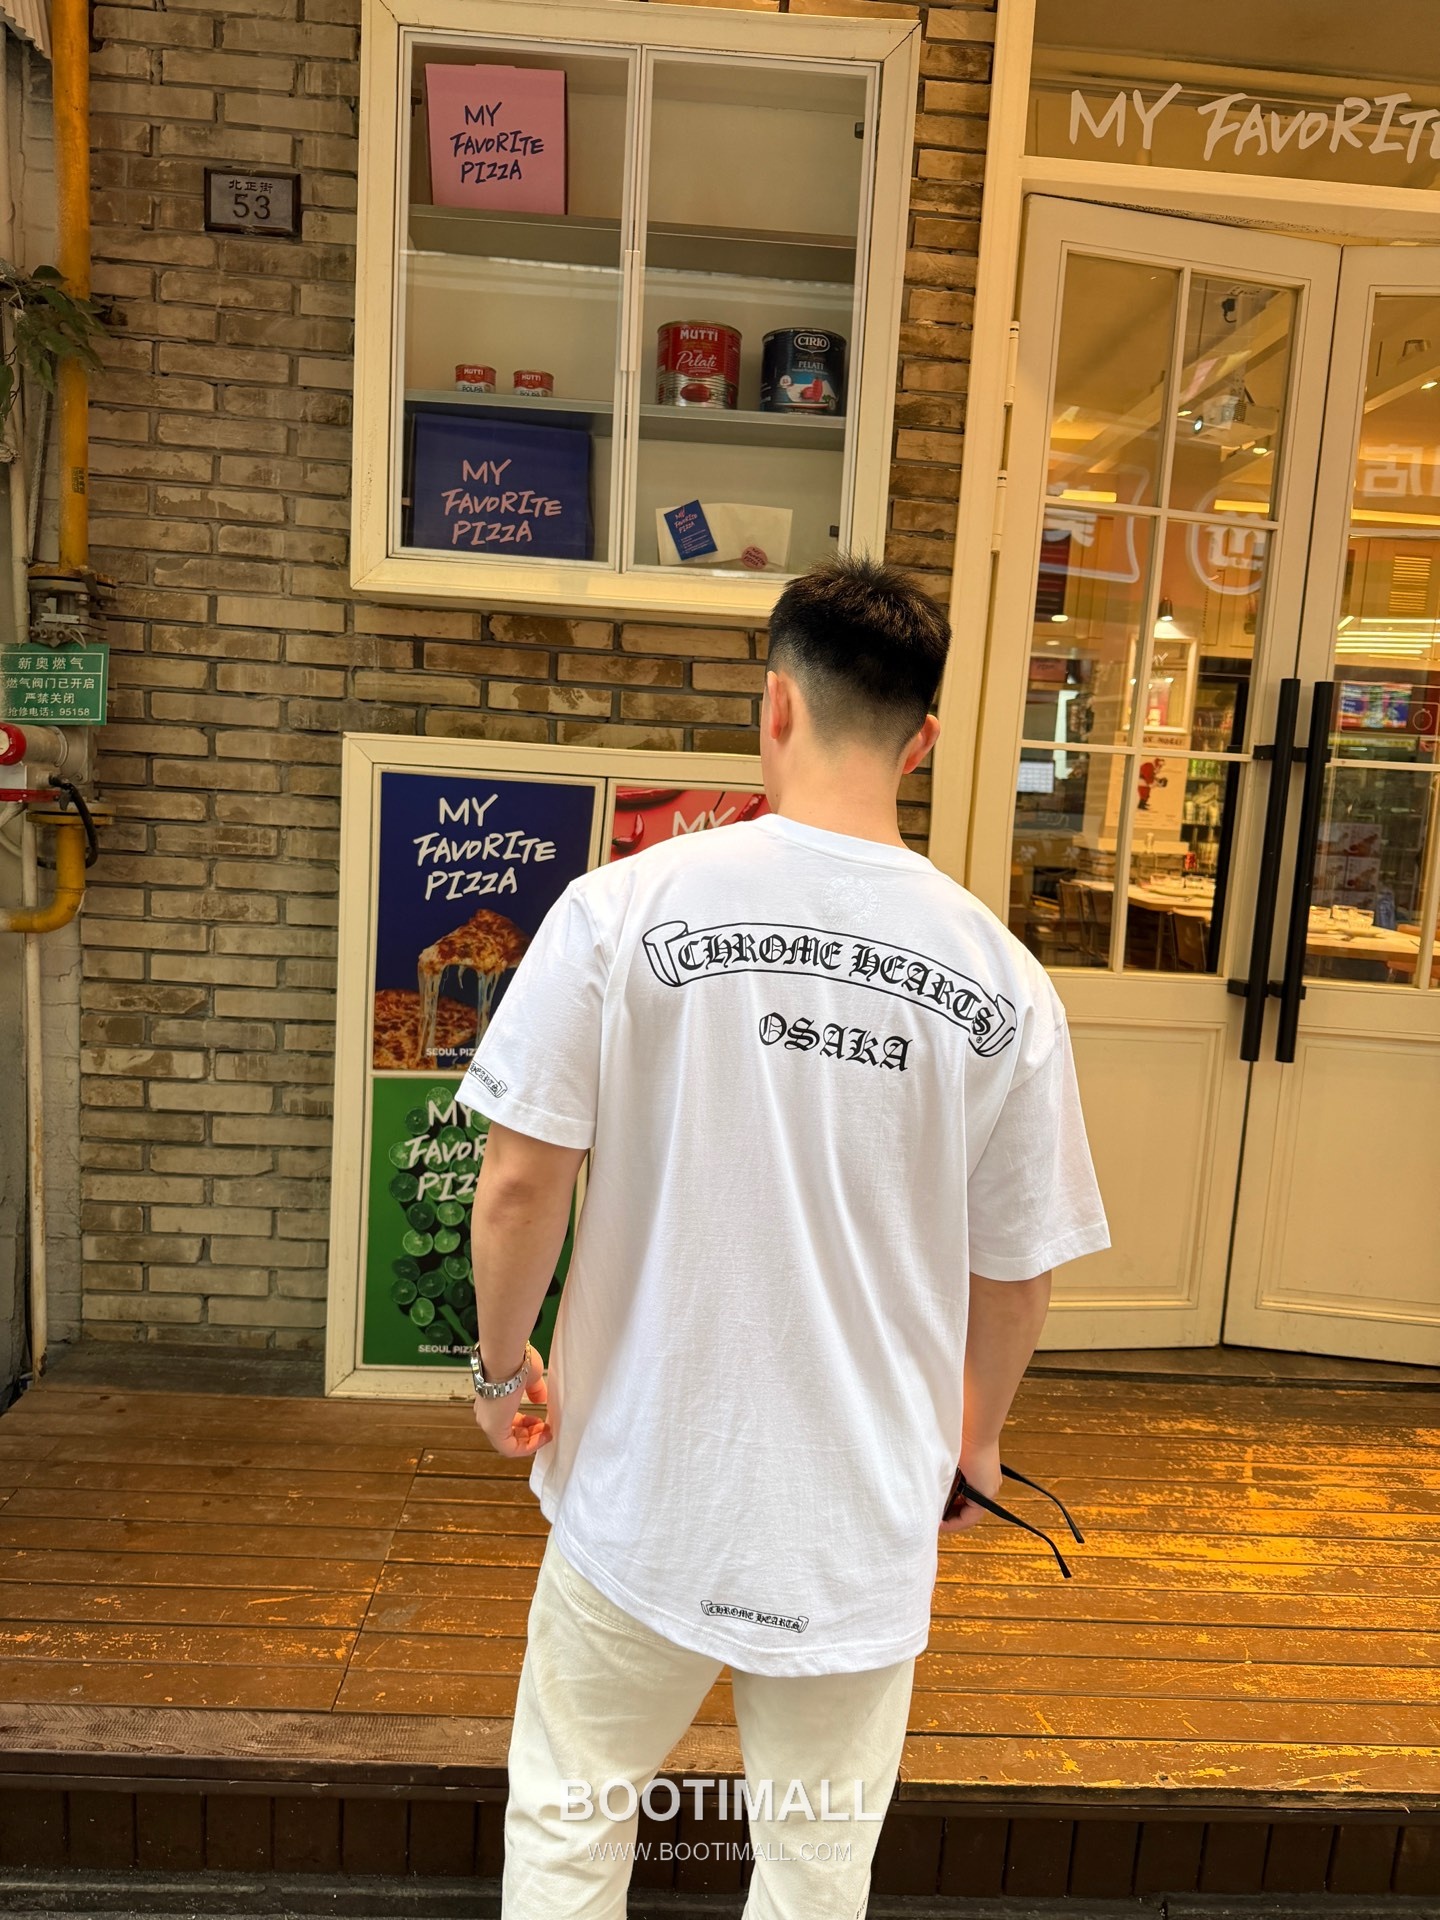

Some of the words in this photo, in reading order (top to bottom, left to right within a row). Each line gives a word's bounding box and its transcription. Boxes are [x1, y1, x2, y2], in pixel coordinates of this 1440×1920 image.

[464, 101, 502, 126] MY
[1069, 82, 1183, 150] MY
[1197, 92, 1440, 163] FAVORIT
[450, 130, 544, 157] FAVORITE
[461, 159, 522, 183] PIZZA
[228, 180, 273, 194] 北正街
[232, 193, 271, 219] 53
[680, 329, 719, 341] MUTTI
[797, 336, 828, 348] CIRIO
[675, 350, 718, 370] Pelati
[798, 361, 825, 370] PELATI
[461, 458, 512, 486] MY
[441, 488, 563, 518] FAVORITE
[452, 520, 533, 546] PIZZA
[18, 657, 84, 670] 新奥燃气
[6, 678, 95, 690] 燃气阀门已开启
[24, 692, 75, 704] 严禁关闭
[438, 793, 499, 827] MY
[412, 829, 557, 867] FAVORITE
[424, 866, 518, 901] PIZZA
[676, 932, 843, 971] CHROME
[848, 942, 996, 1036] HEARTS
[425, 1047, 458, 1057] SEOUL
[459, 1047, 479, 1057] PIZ
[758, 1011, 914, 1073] OSAKA
[428, 1100, 474, 1128] MY
[404, 1134, 489, 1169] FAVOR
[416, 1171, 480, 1202] PIZ
[418, 1344, 452, 1353] SEOUL
[708, 1605, 755, 1620] CHROME
[755, 1613, 801, 1630] HEARTS
